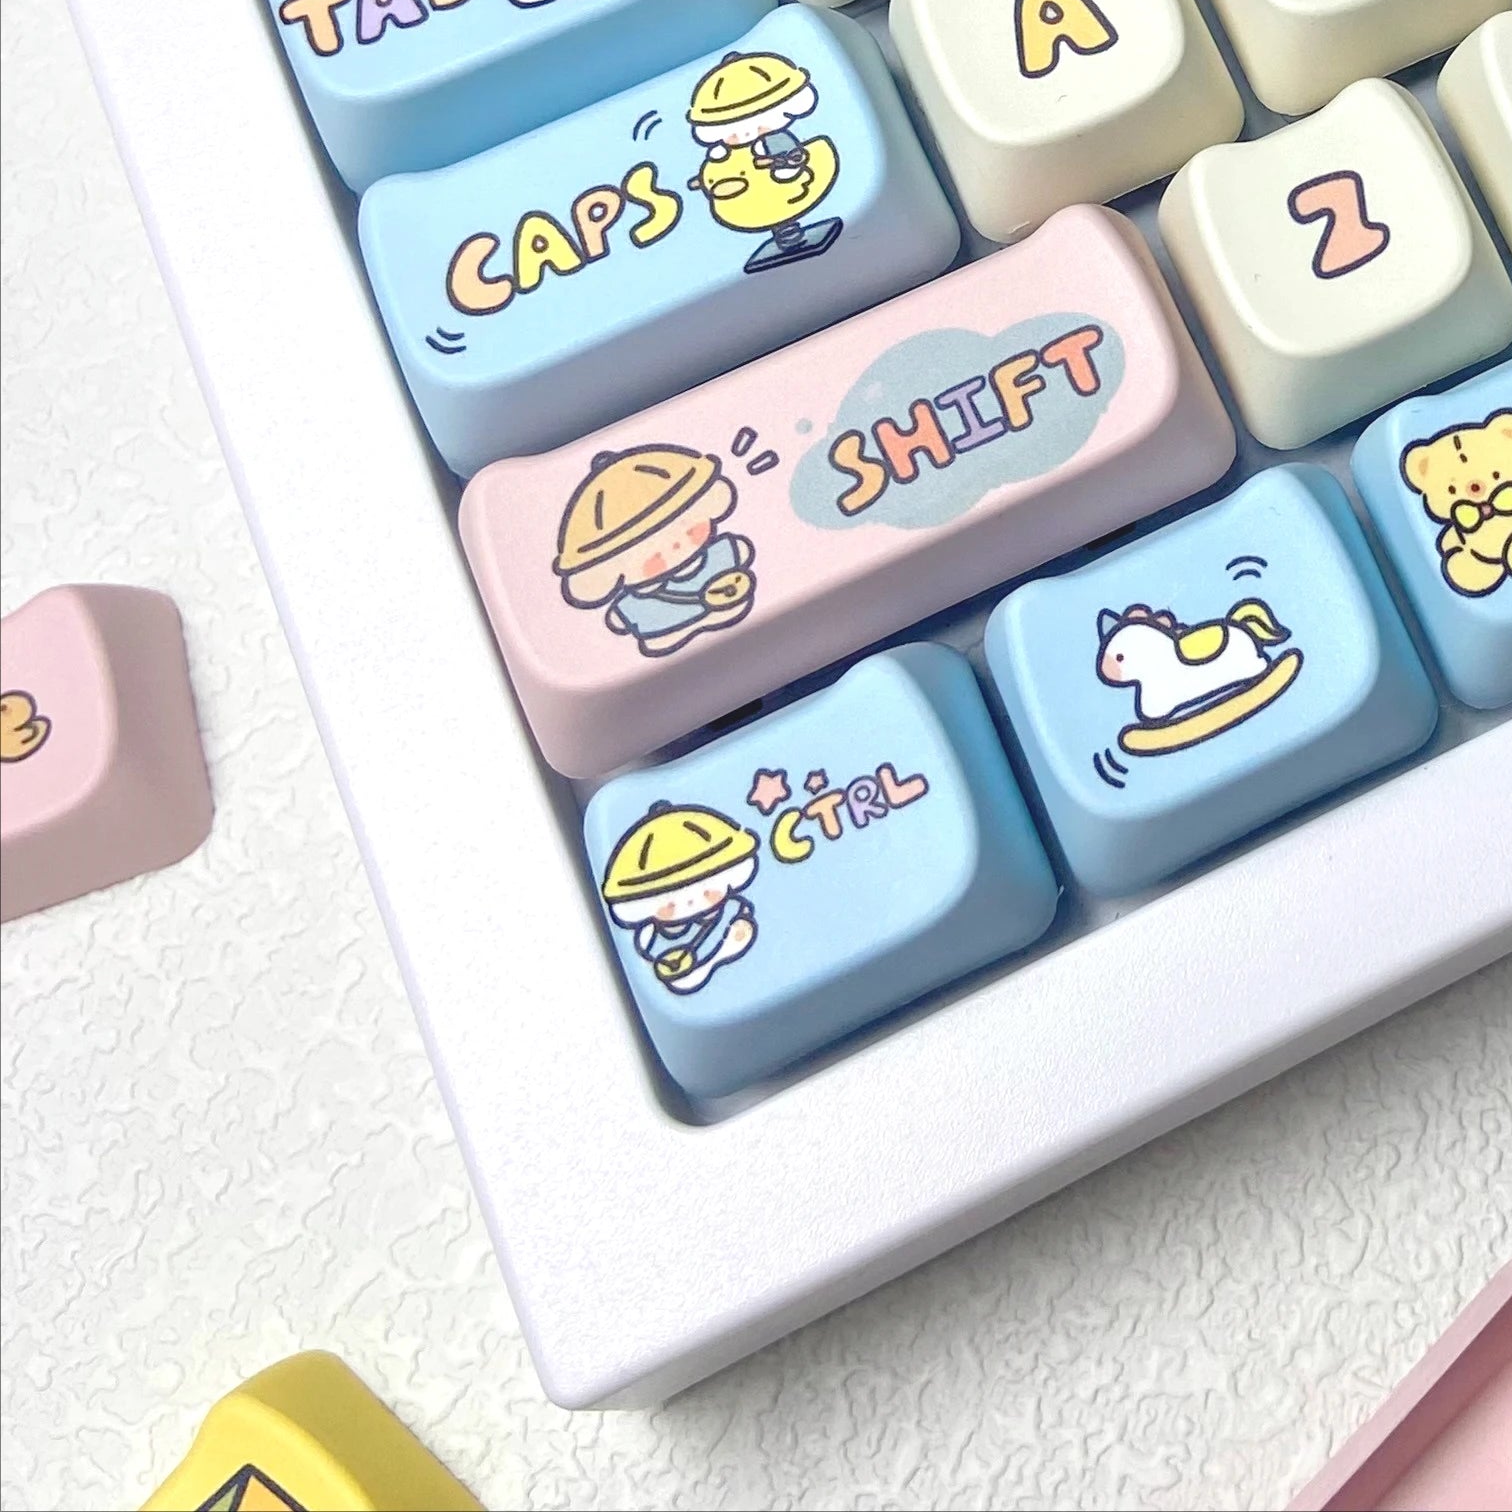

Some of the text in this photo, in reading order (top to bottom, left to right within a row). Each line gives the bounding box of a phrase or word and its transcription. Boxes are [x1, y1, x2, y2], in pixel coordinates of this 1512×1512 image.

[446, 160, 684, 316] CAPS
[1286, 169, 1391, 280] Z
[828, 324, 1105, 517] SHIFT
[769, 762, 930, 864] CTRL
